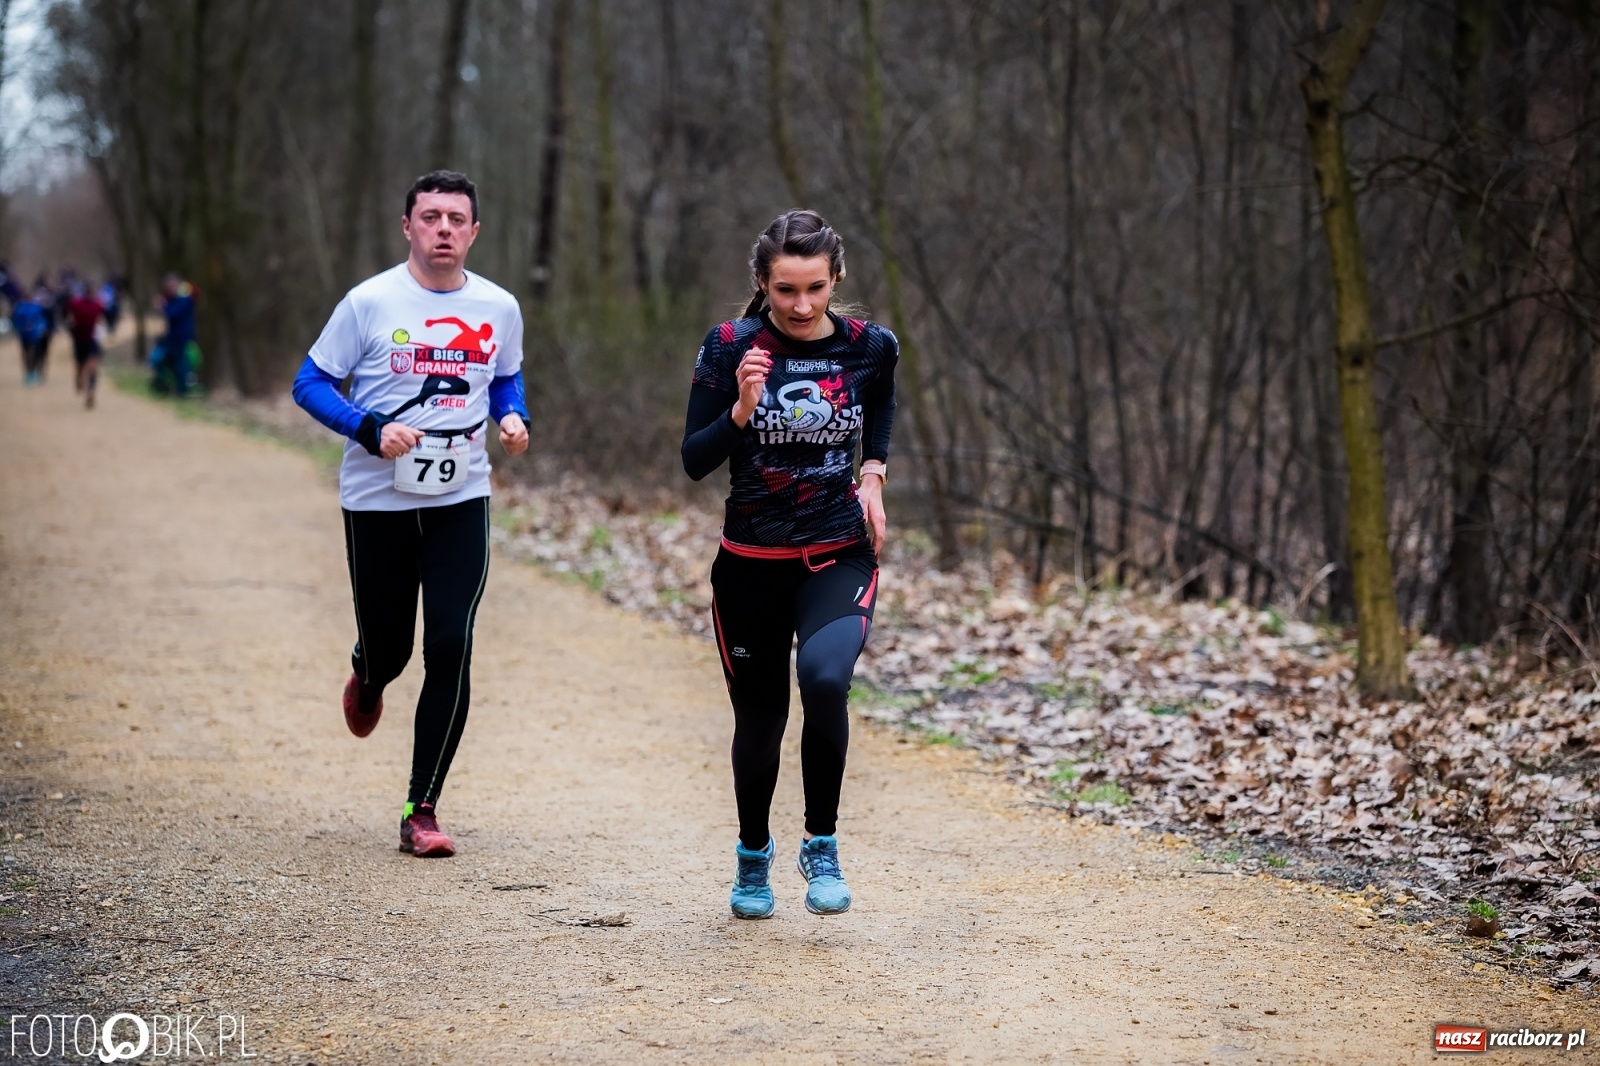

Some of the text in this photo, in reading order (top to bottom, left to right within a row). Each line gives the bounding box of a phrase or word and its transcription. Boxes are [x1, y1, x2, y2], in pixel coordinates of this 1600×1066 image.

[416, 349, 488, 363] XI BIEG BEZ
[415, 361, 465, 375] GRANIC
[788, 361, 827, 369] EXTREME
[758, 430, 850, 446] TRENING
[414, 457, 456, 483] 79
